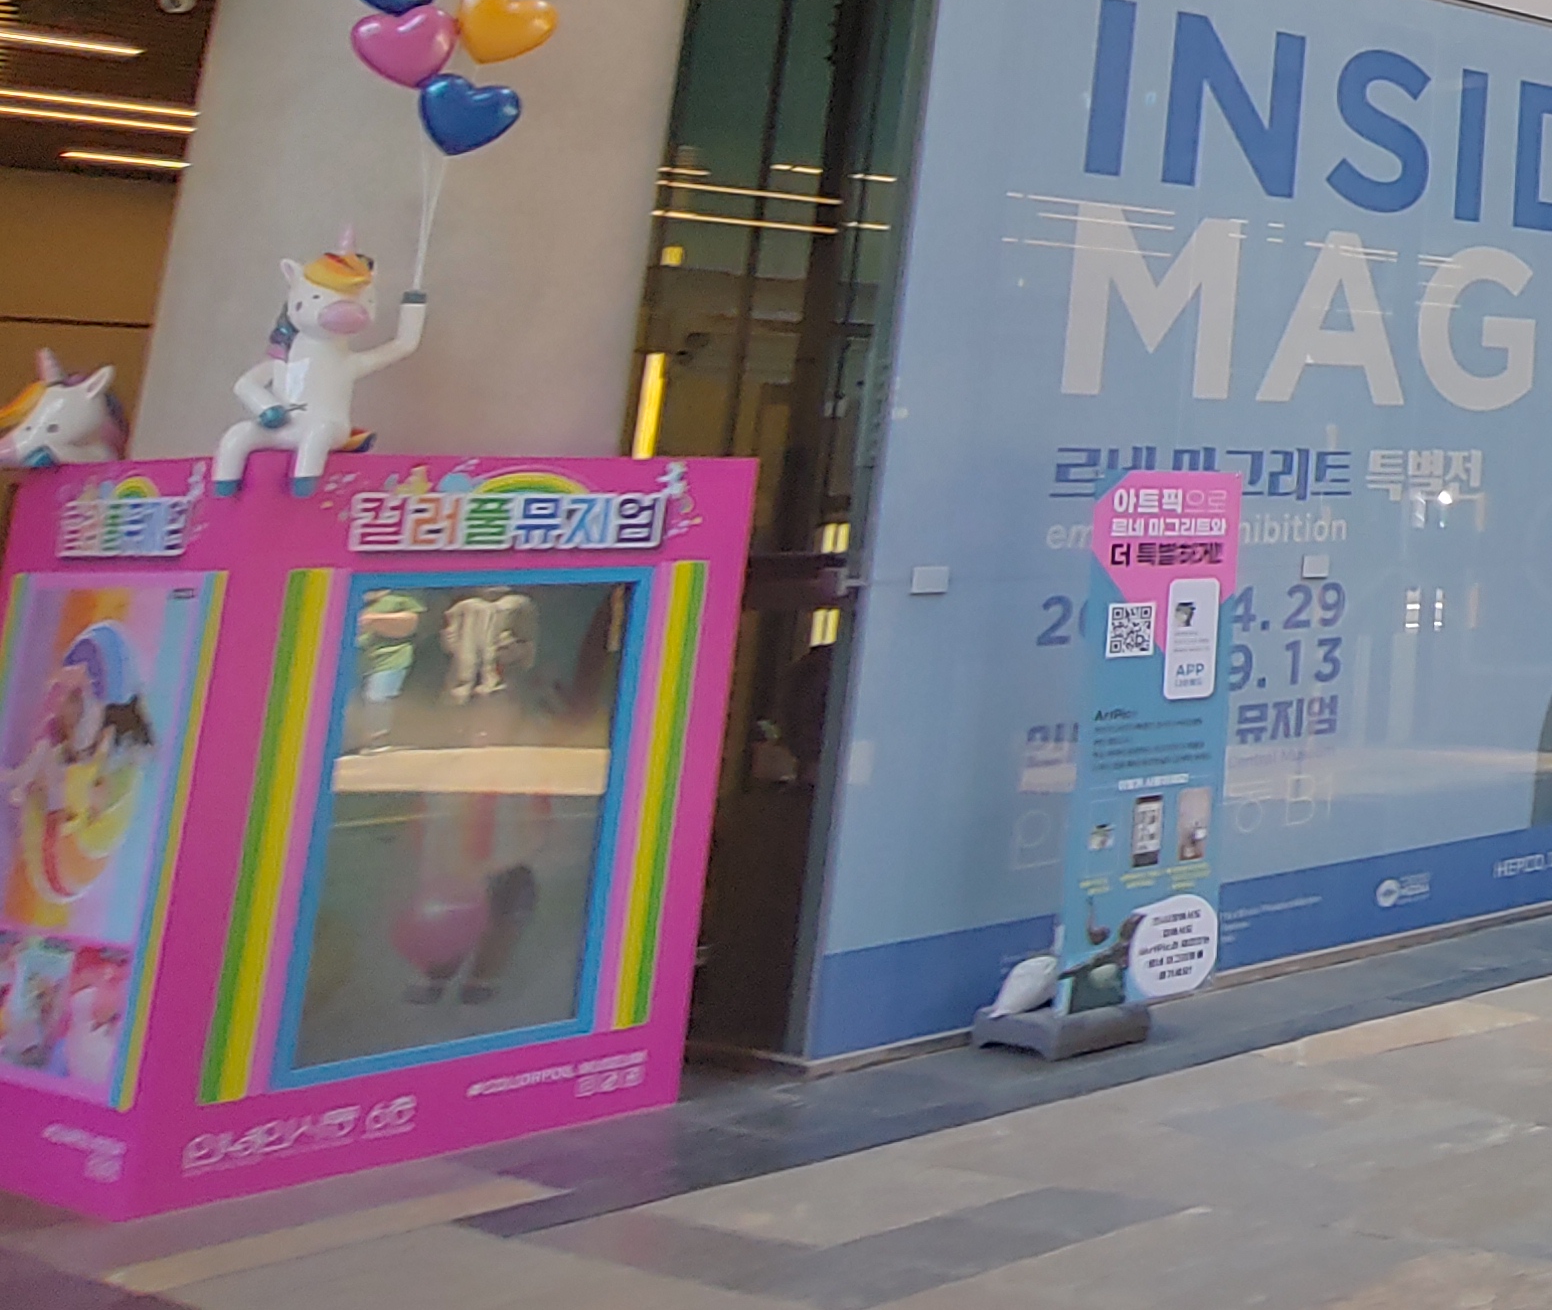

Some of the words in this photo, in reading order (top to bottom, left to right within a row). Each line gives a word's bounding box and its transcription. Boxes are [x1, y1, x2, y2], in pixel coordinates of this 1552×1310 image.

[1113, 488, 1227, 514] 아트픽으로
[1110, 518, 1145, 537] 르네
[1149, 517, 1227, 537] 마그리트와
[1110, 543, 1132, 568] 더
[1175, 663, 1205, 677] APP
[1236, 695, 1339, 745] 뮤지엄
